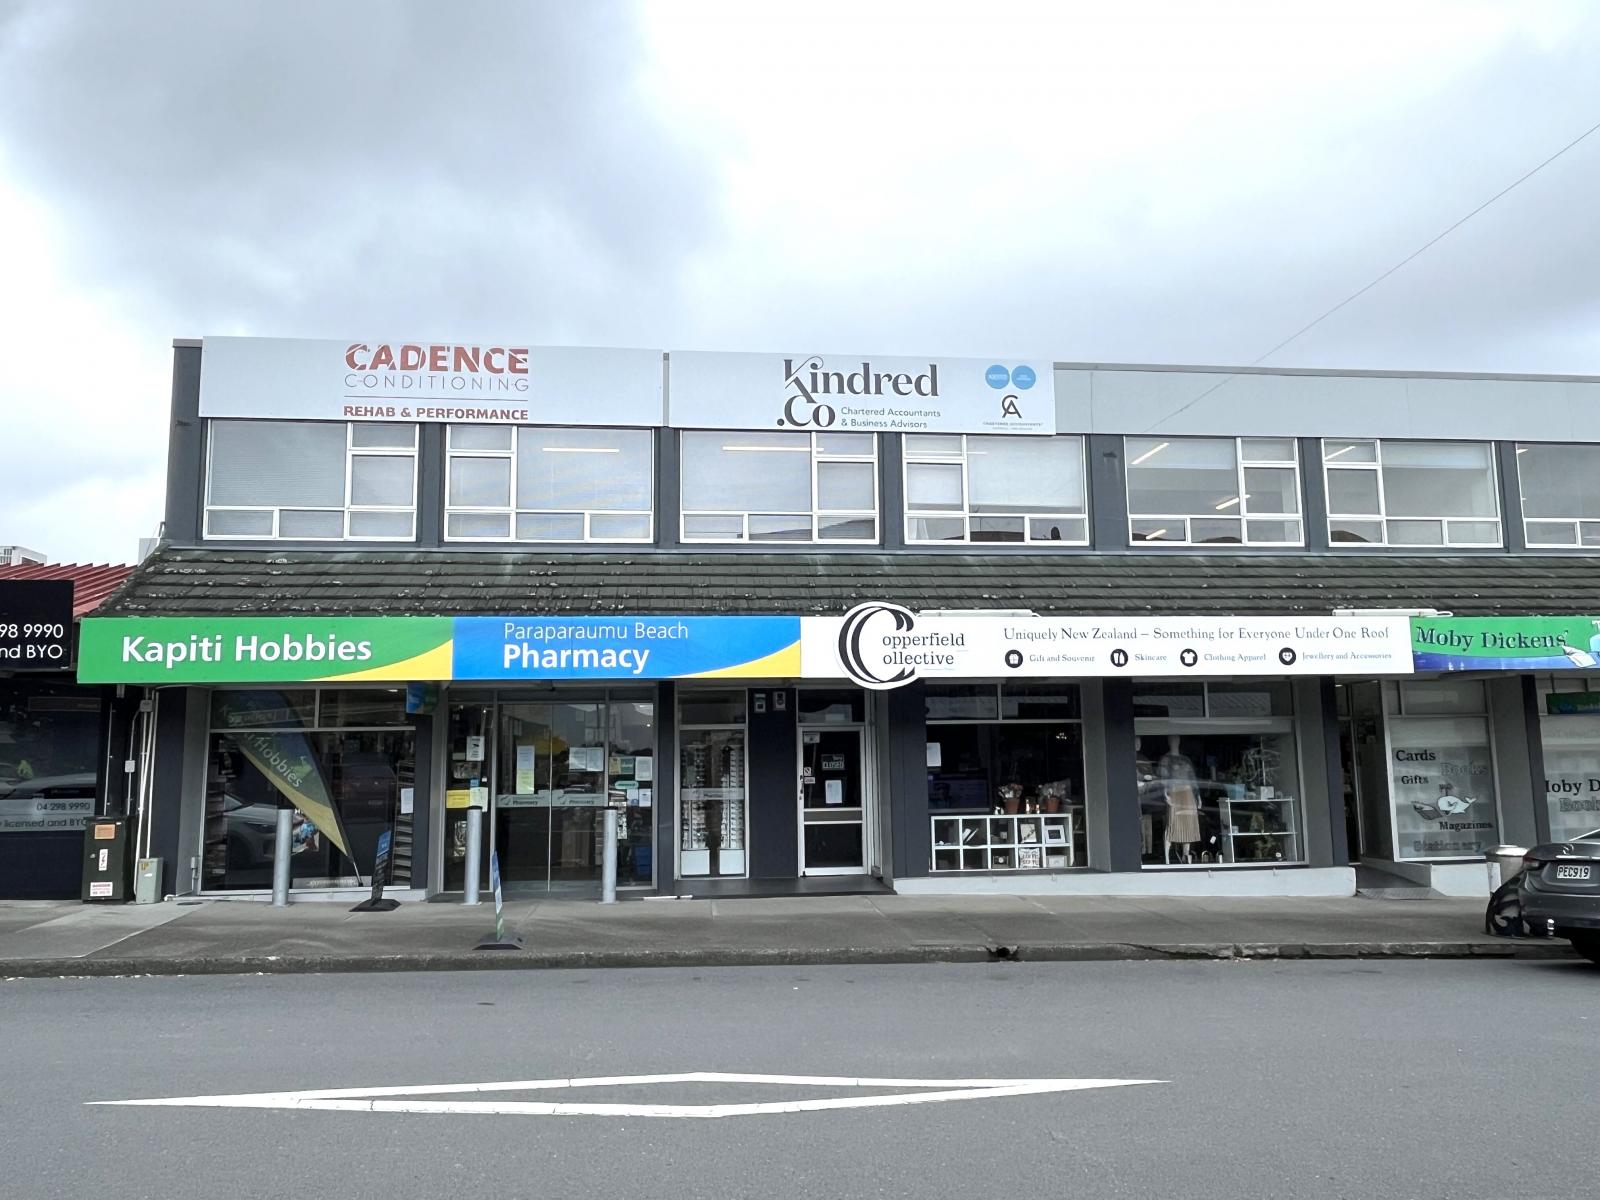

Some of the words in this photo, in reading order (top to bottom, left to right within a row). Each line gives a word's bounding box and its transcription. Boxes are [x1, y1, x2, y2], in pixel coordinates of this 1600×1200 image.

[345, 343, 529, 375] CADENCE
[344, 374, 529, 391] CONDITIONING
[784, 356, 939, 403] Kindred
[344, 405, 396, 418] REHAB
[400, 407, 412, 418] &
[416, 407, 529, 420] PERFORMANCE
[841, 406, 885, 416] Chartered
[888, 408, 941, 418] Accountants
[841, 418, 848, 427] &
[850, 418, 888, 428] Business
[890, 419, 927, 429] Advisors
[23, 623, 64, 638] 9990
[504, 622, 628, 643] Paraparaumu
[635, 621, 689, 639] Beach
[1004, 627, 1058, 642] Uniquely
[1061, 627, 1089, 640] New
[1092, 627, 1137, 640] Zealand
[1153, 627, 1214, 642] Something
[1218, 626, 1234, 639] for
[1239, 627, 1291, 641] Everyone
[1295, 626, 1330, 639] Under
[1332, 626, 1357, 639] One
[1361, 626, 1390, 639] Roof
[1416, 627, 1473, 651] Moby
[26, 644, 63, 659] BYO
[122, 634, 223, 669] Kapiti
[235, 633, 372, 661] Hobbies
[503, 641, 650, 674] Pharmacy
[1029, 654, 1045, 663] Gift
[1047, 654, 1060, 663] and
[1062, 654, 1095, 663] Souvenir
[1134, 653, 1167, 662] Skincare
[1203, 653, 1235, 662] Clothing
[1237, 653, 1267, 663] Apparel
[1302, 651, 1336, 662] Jewellery
[1338, 651, 1349, 661] and
[253, 736, 303, 788] Hobbies
[1395, 749, 1436, 762] Cards
[1401, 775, 1429, 785] Gifts
[36, 803, 48, 811] 04
[50, 803, 67, 811] 298
[68, 802, 91, 811] 9990
[4, 818, 45, 828] licensed
[47, 818, 67, 828] and
[1439, 821, 1494, 832] Magazines
